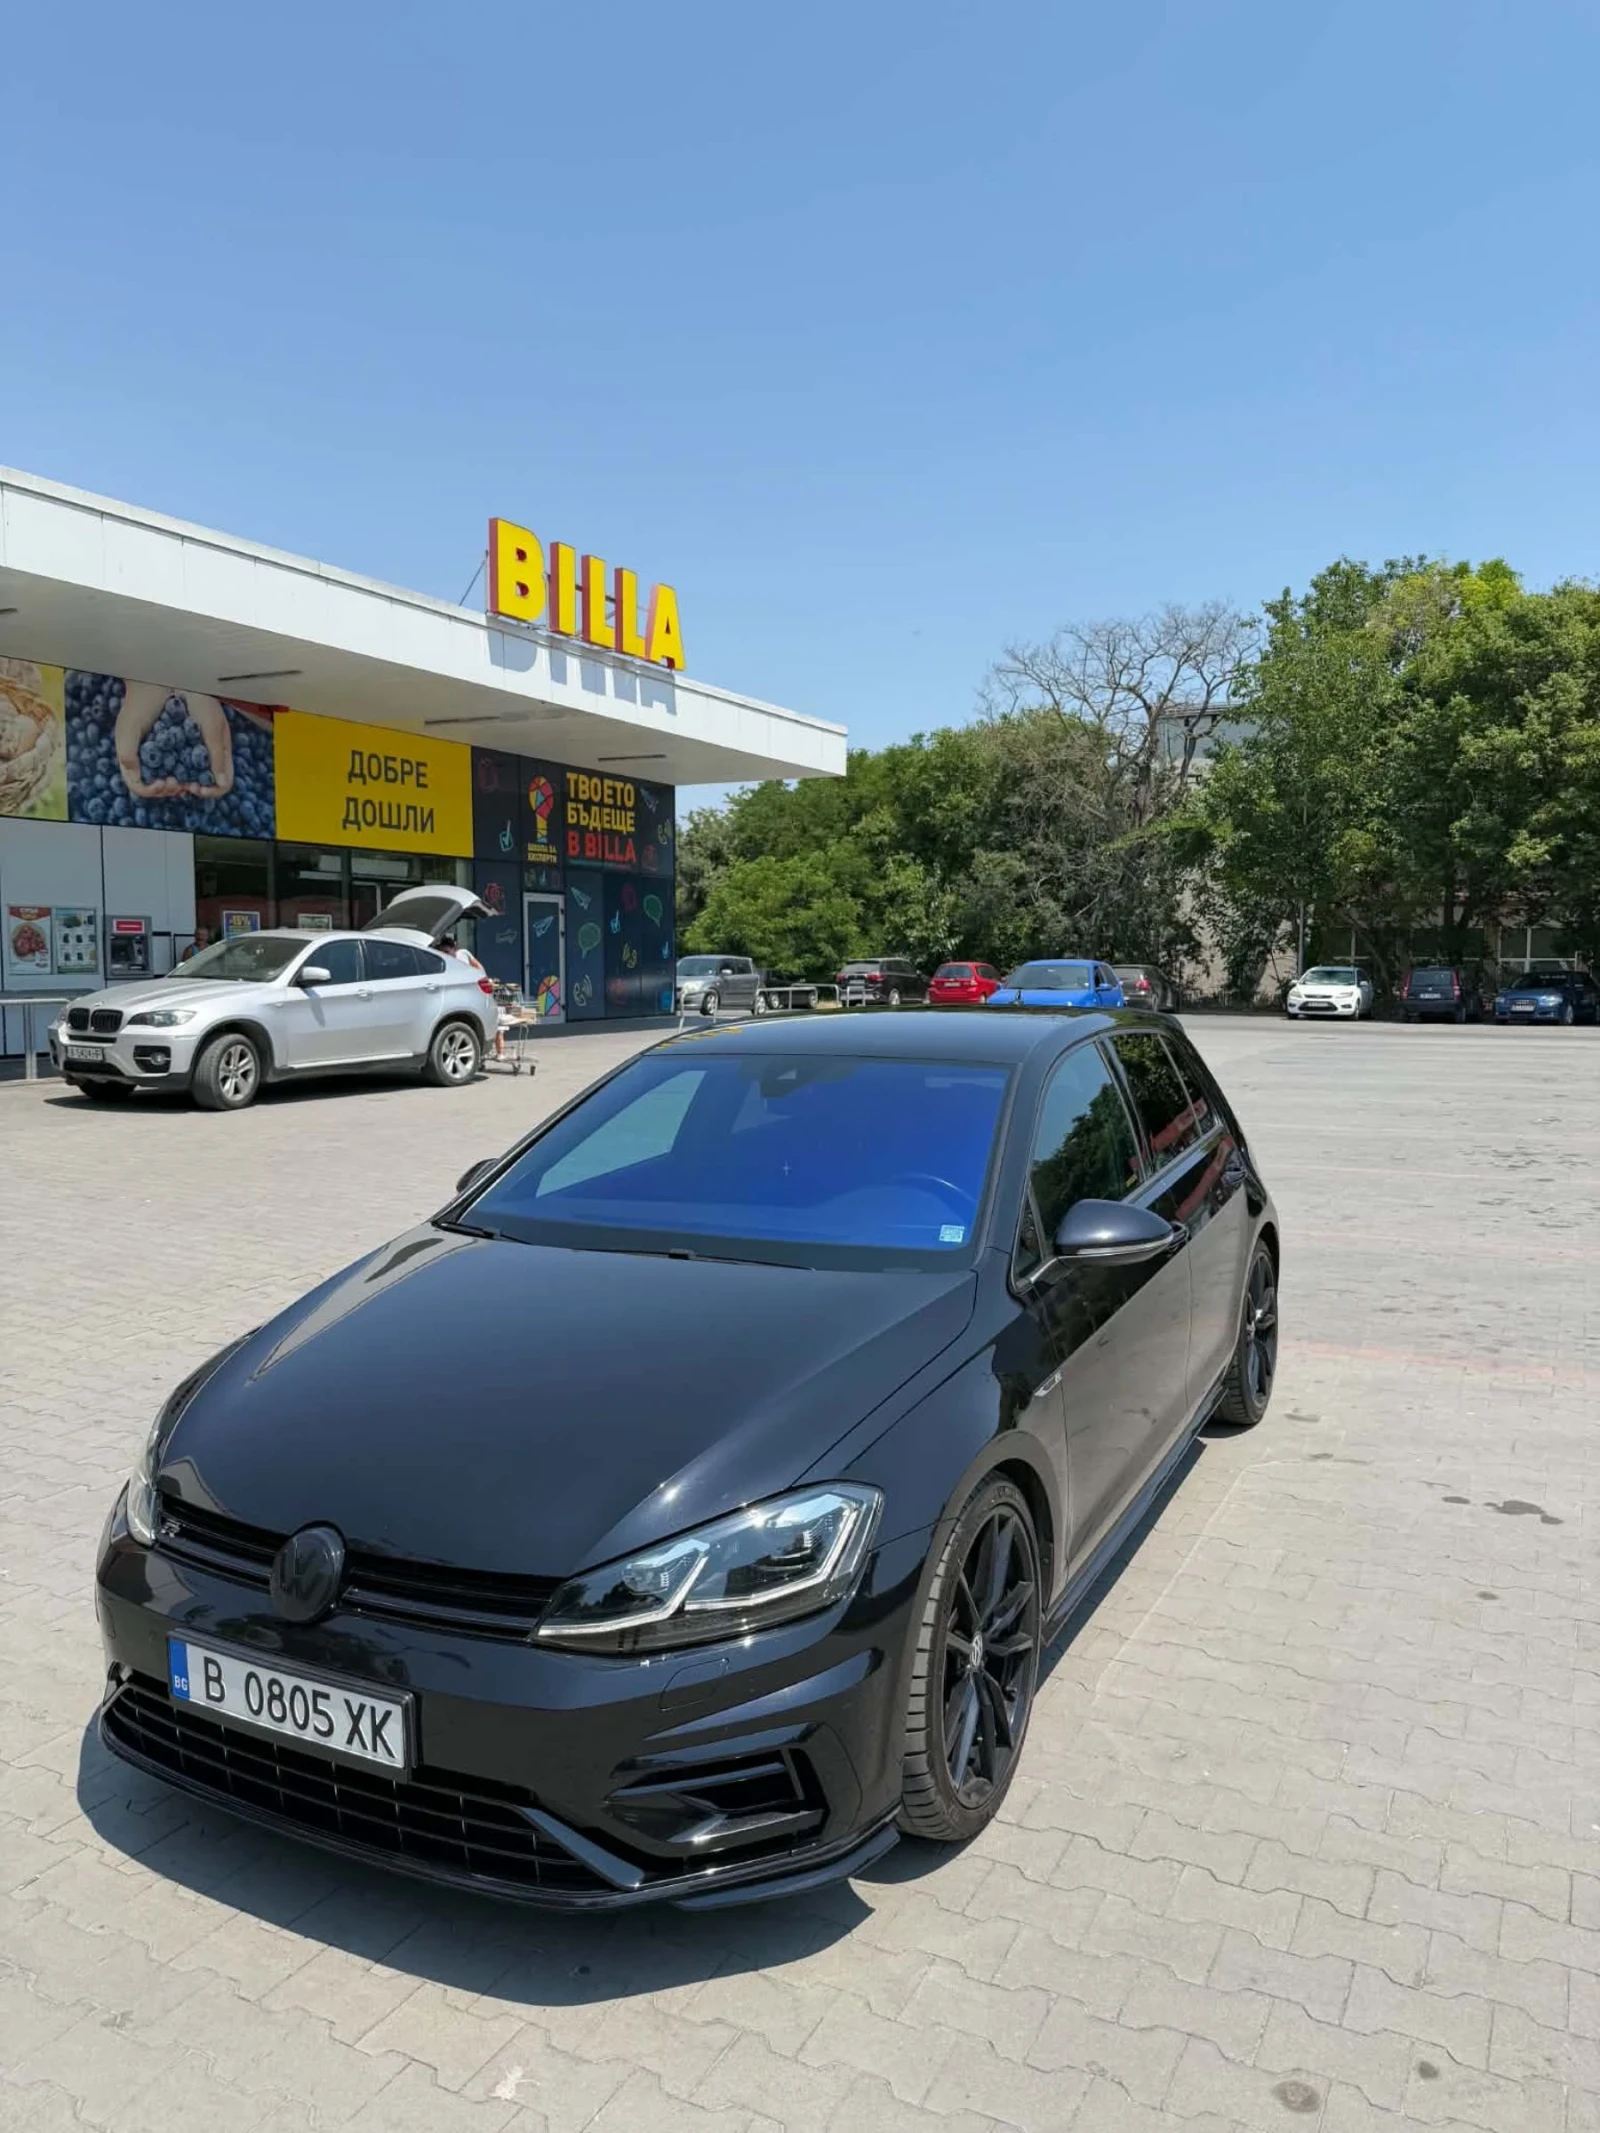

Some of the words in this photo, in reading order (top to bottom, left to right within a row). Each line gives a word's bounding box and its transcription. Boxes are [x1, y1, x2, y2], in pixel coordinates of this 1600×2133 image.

[489, 517, 687, 672] BILLA
[348, 749, 428, 789] ДОБРЕ
[566, 772, 635, 808] ТВОЕТО
[342, 796, 434, 834] ДОШЛИ
[566, 802, 635, 835] БЪДЕЩЕ
[585, 832, 637, 863] BILLA
[173, 1675, 188, 1691] BG
[203, 1656, 226, 1703] B
[244, 1671, 335, 1738] 0805
[343, 1698, 396, 1759] XK
